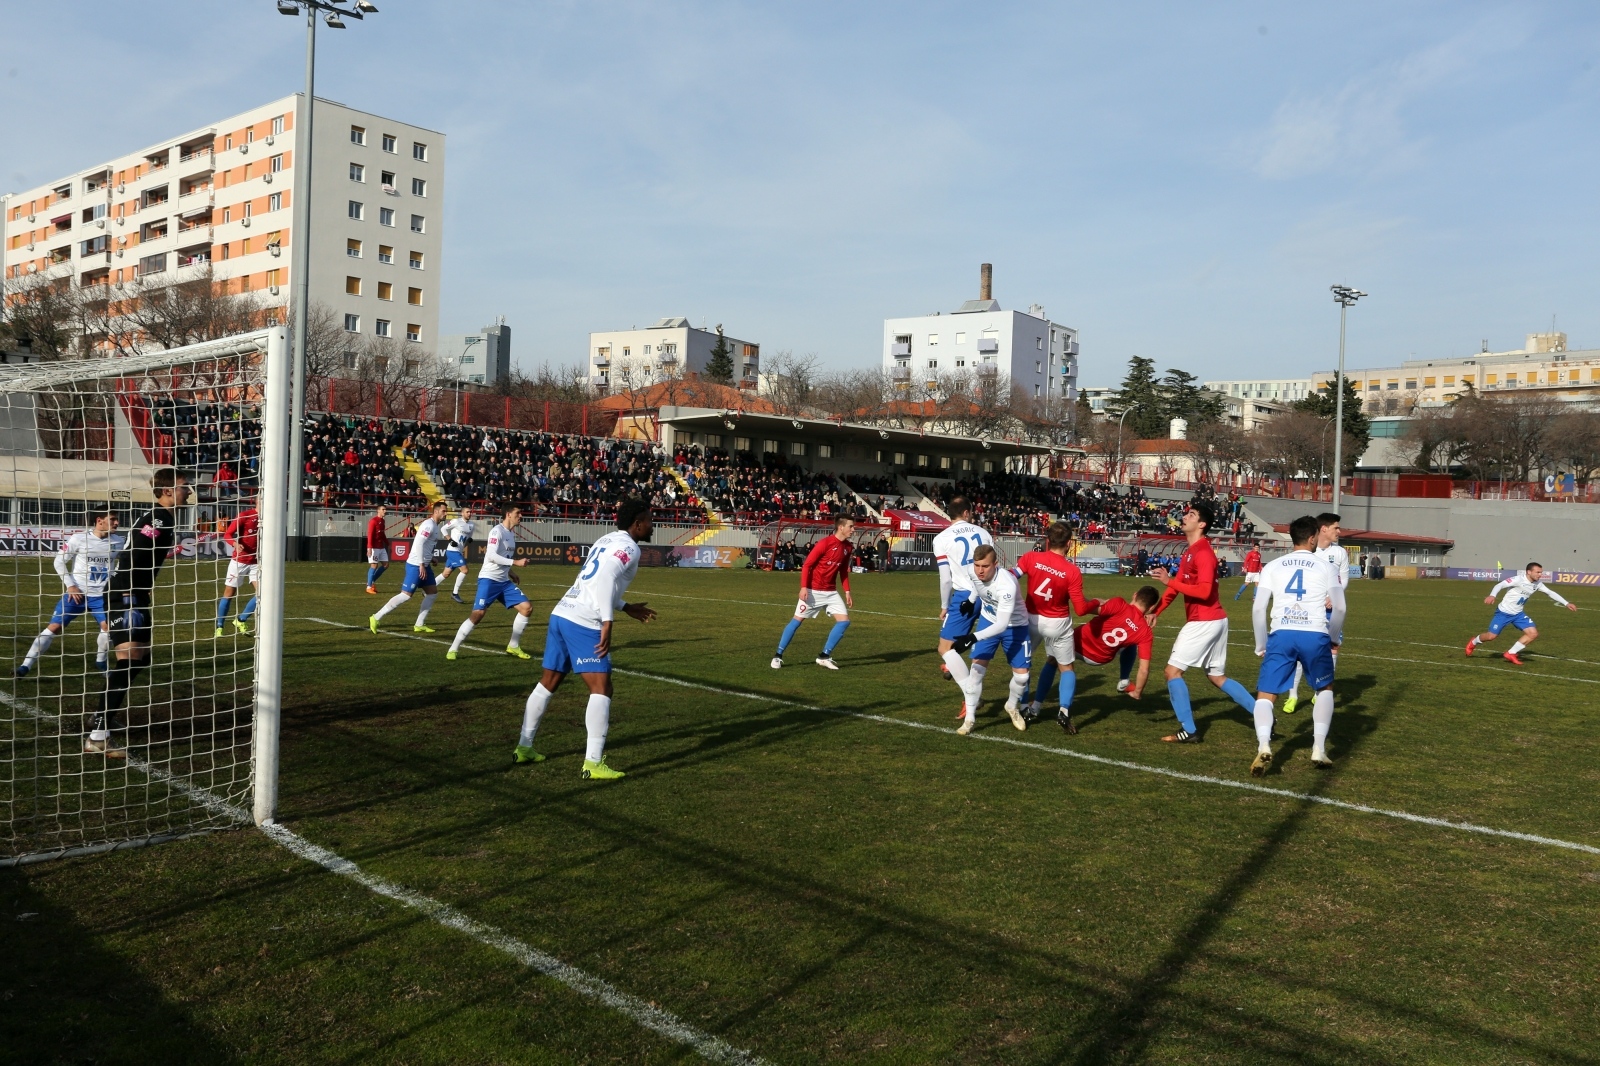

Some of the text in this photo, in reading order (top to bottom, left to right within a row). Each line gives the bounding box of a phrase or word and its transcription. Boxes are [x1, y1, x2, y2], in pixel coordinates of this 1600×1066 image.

[954, 533, 983, 566] 21
[893, 556, 931, 566] TEXTUM
[1281, 559, 1315, 569] GUTIERI
[1472, 571, 1502, 580] RESPECT
[1033, 577, 1053, 601] 4
[1285, 568, 1307, 602] 4
[799, 604, 807, 614] 9
[1101, 627, 1128, 648] 8
